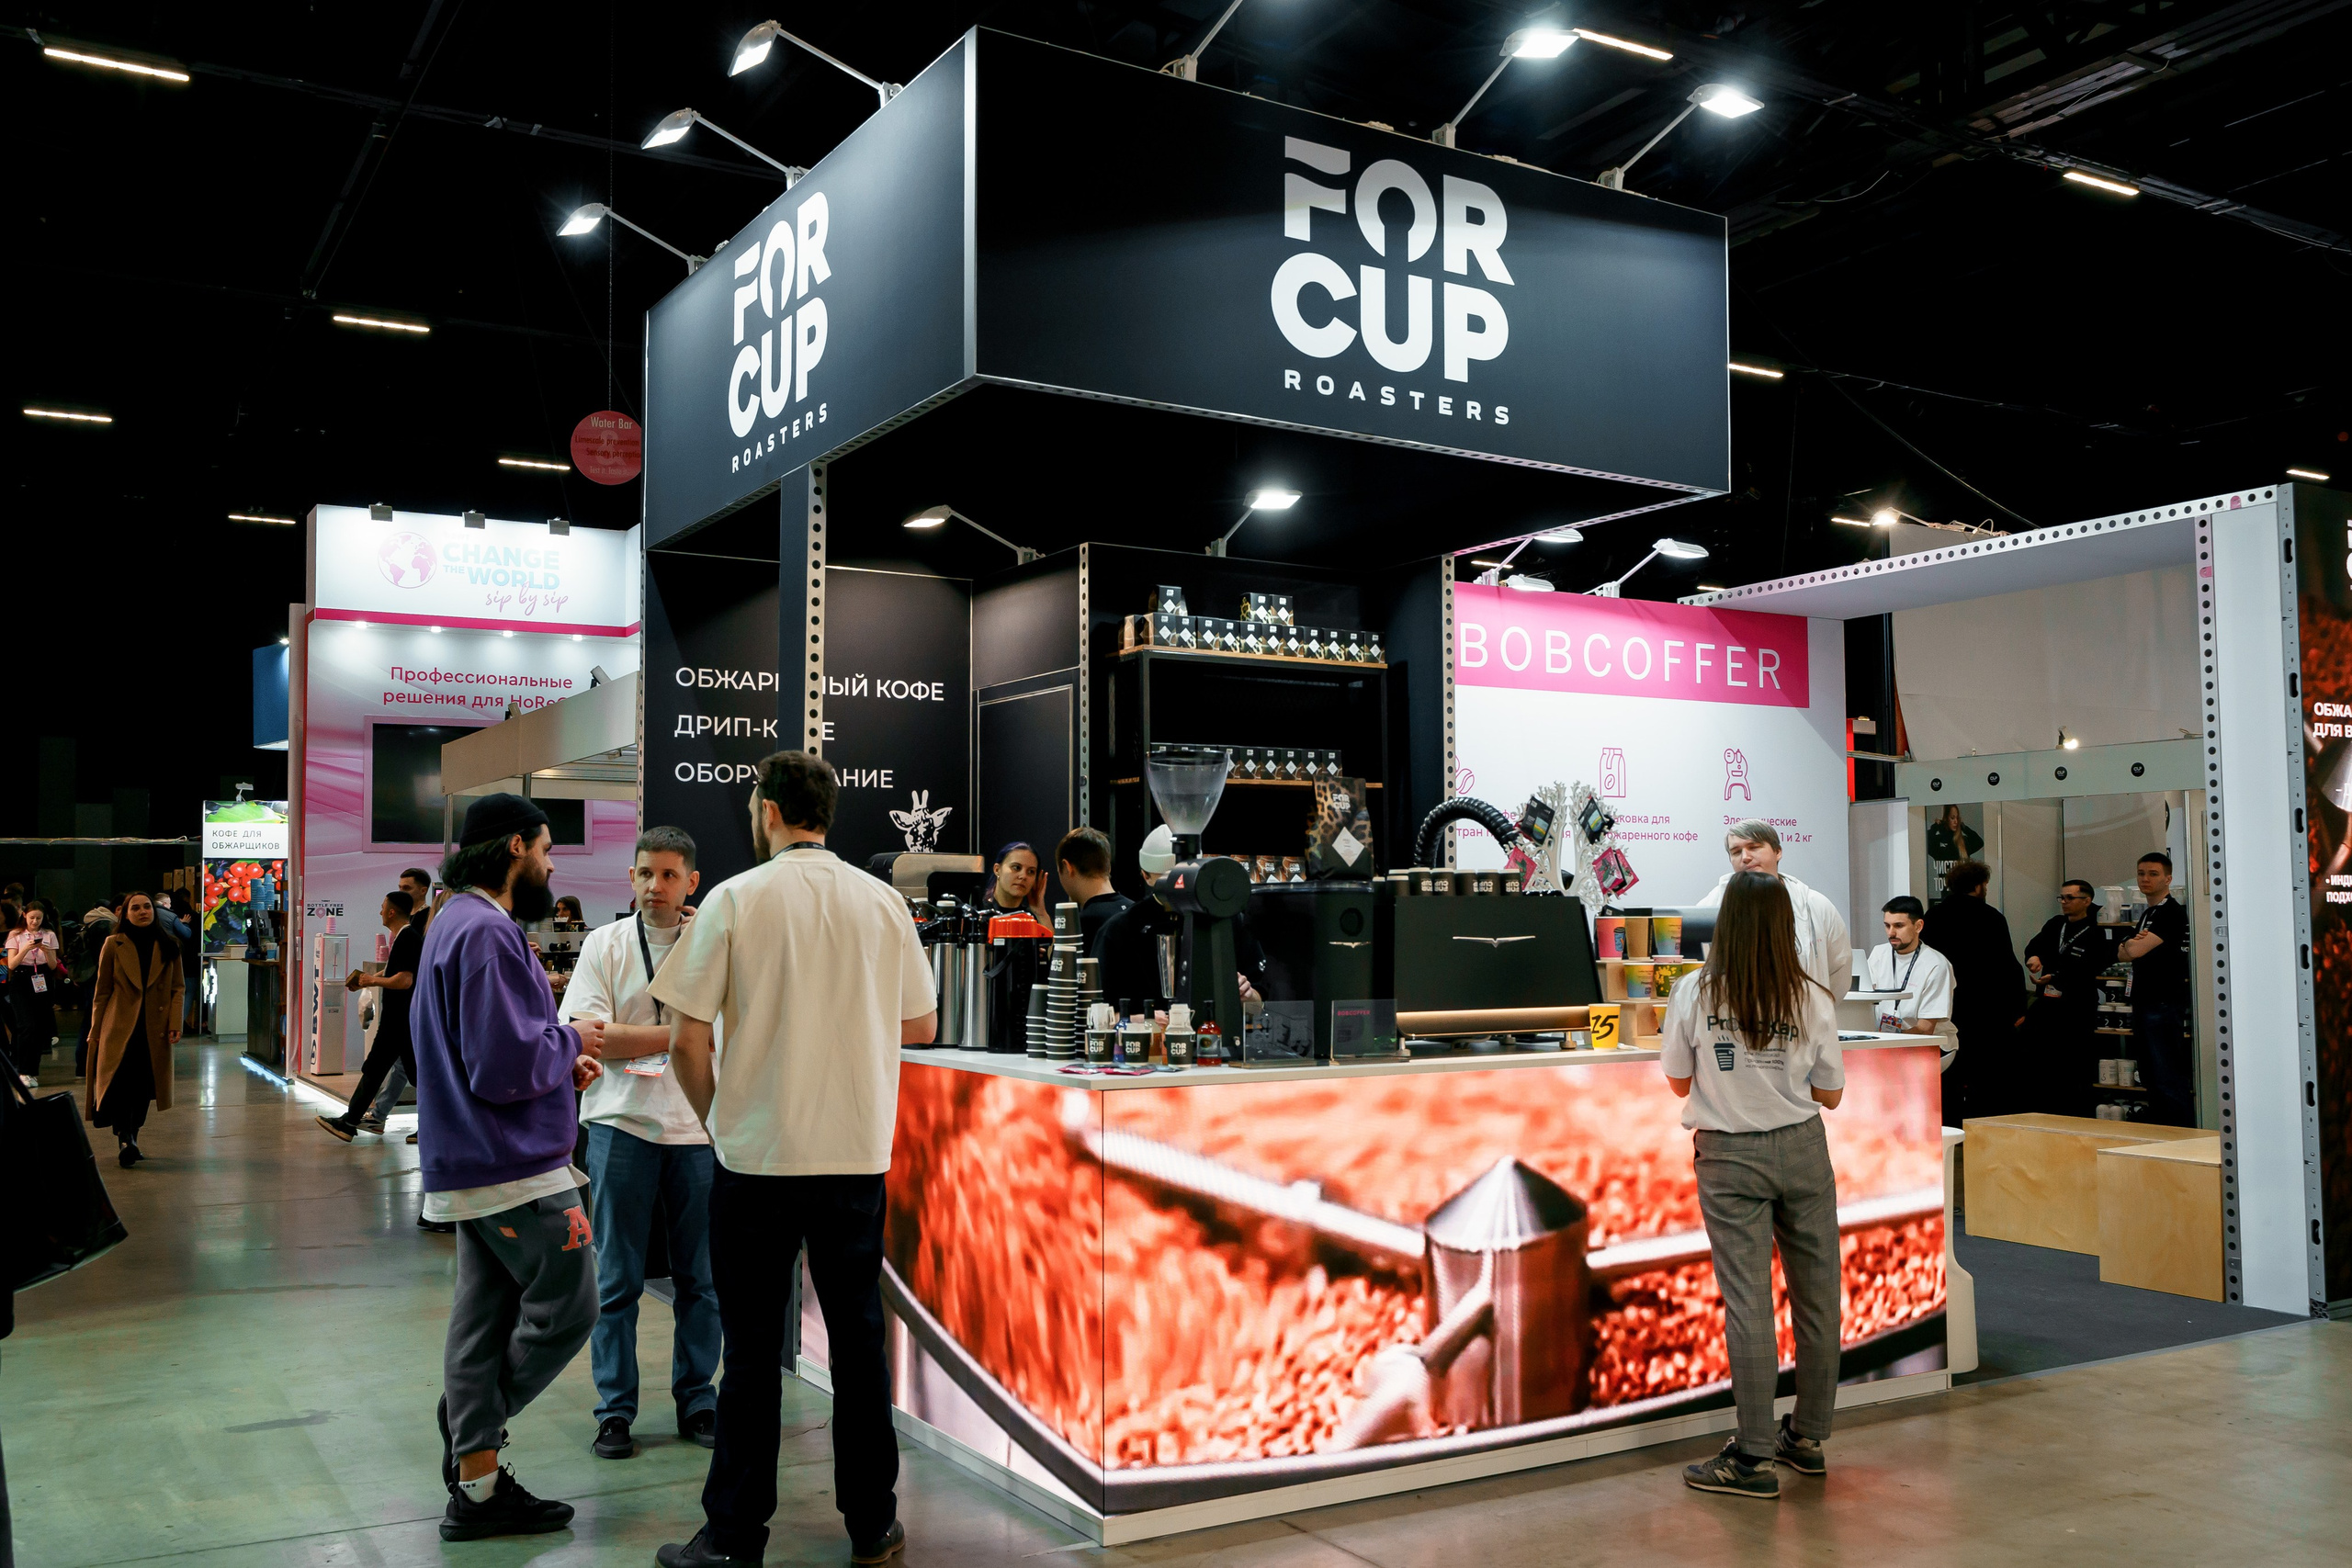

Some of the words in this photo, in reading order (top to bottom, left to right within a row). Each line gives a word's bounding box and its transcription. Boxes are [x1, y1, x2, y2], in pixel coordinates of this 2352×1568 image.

[1284, 135, 1515, 286] FOR
[733, 191, 831, 346] FOR
[1271, 252, 1510, 383] CUP
[728, 297, 828, 438] CUP
[1284, 369, 1510, 425] ROASTERS
[591, 416, 616, 428] Water
[618, 418, 633, 429] Bar
[732, 402, 827, 473] ROASTERS
[612, 450, 640, 459] perceptio
[442, 543, 560, 570] CHANGE
[443, 564, 465, 574] THE
[468, 568, 560, 591] WORLD
[486, 592, 512, 614] sip
[518, 581, 537, 616] by
[543, 592, 569, 614] sip
[1460, 622, 1781, 690] BOBCOFFER
[390, 667, 572, 689] Профессиональные
[675, 667, 868, 697] ОБЖАРЫЙ
[876, 678, 944, 702] КОФЕ
[383, 690, 468, 711] решения
[471, 695, 504, 710] для
[511, 694, 567, 709] HoRe
[674, 714, 835, 741] ДРИП-КЕ
[2312, 722, 2344, 739] ДЛЯ
[1332, 793, 1350, 803] FOR
[1333, 801, 1351, 810] CUP
[1613, 815, 1649, 824] аковка
[1651, 816, 1670, 825] для
[212, 829, 238, 838] КОФЕ
[243, 830, 262, 839] ДЛЯ
[1456, 828, 1483, 839] тран
[1673, 830, 1699, 843] кофе
[1786, 834, 1792, 842] и
[1794, 832, 1801, 842] 2
[1802, 834, 1813, 842] кг
[211, 841, 280, 851] ОБЖАРЩИКОВ
[561, 1205, 594, 1252] A
